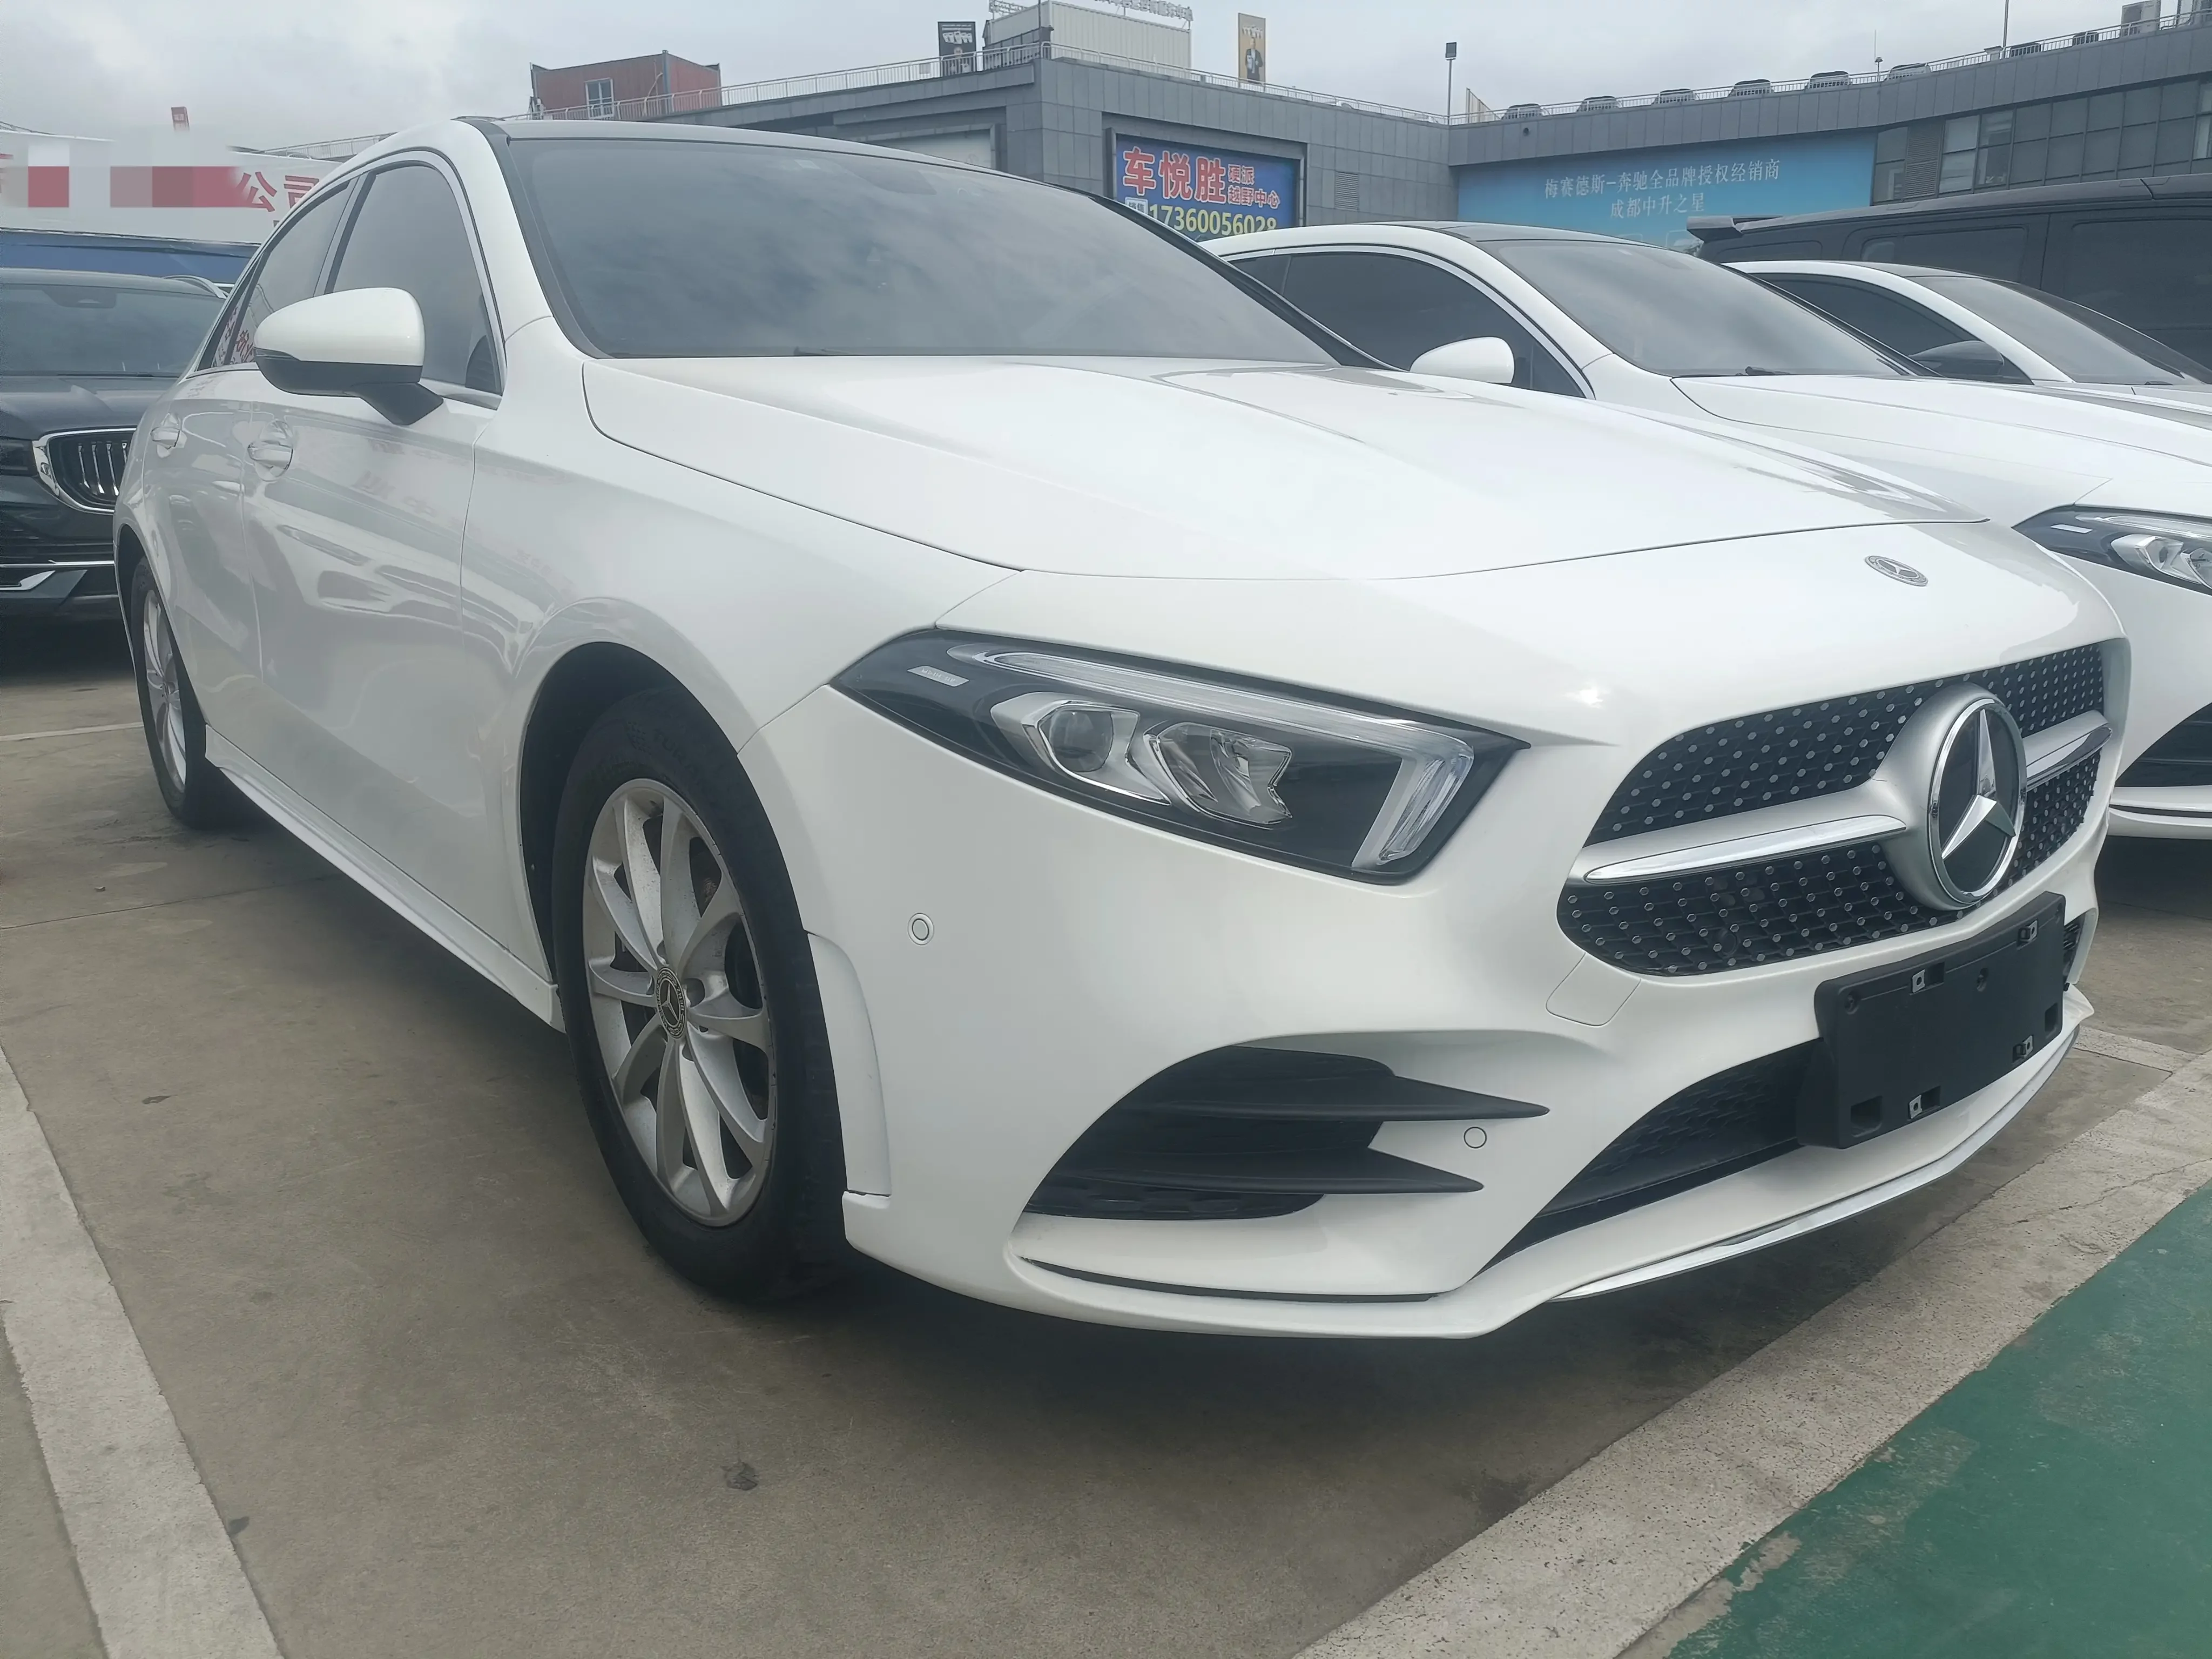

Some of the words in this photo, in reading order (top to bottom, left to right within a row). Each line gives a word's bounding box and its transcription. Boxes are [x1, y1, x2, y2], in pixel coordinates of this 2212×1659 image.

[1123, 146, 1226, 204] 车悦胜
[1228, 164, 1255, 185] 硬派
[1228, 185, 1280, 209] 越野中心
[1610, 192, 1705, 219] 成都中升之星
